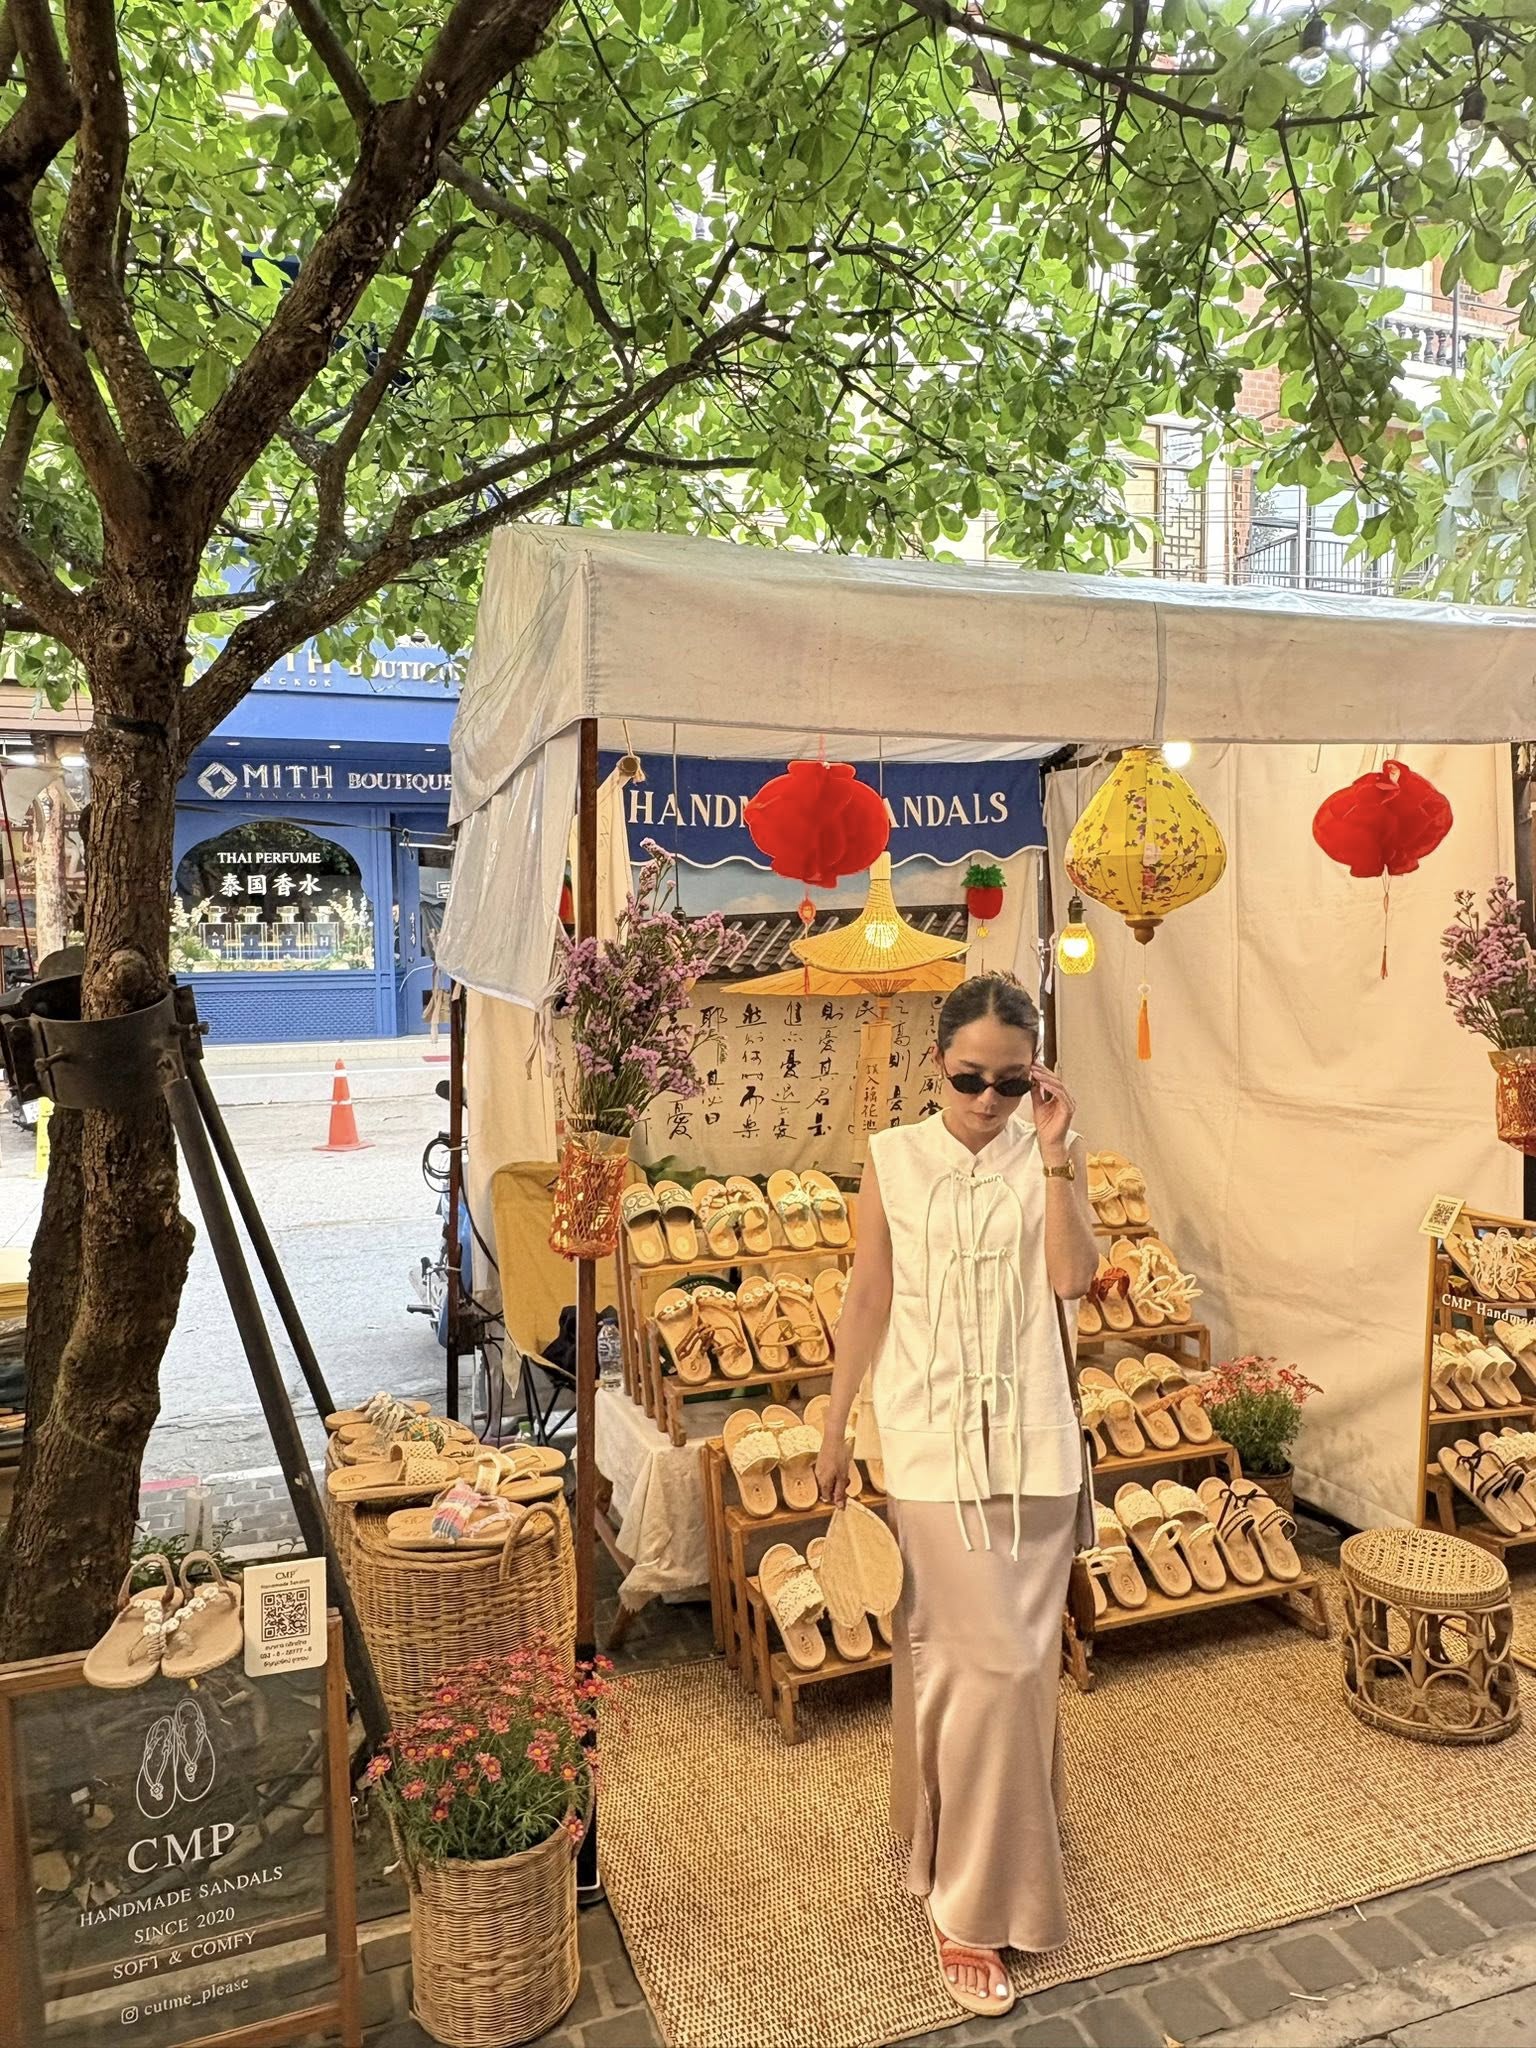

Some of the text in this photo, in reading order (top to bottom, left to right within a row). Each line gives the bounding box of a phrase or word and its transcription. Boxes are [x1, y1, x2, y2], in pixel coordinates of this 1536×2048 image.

[242, 763, 453, 794] MITH BOUTIQUE
[628, 790, 1008, 829] HAND ANDALS
[217, 852, 322, 864] THAI PERFUME
[219, 872, 323, 898] 泰国香水
[1442, 1293, 1472, 1311] CMP
[127, 1822, 235, 1874] CMP
[79, 1866, 283, 1928] HANDMADE SANDALS
[134, 1906, 236, 1944] SINCE 2020
[113, 1930, 257, 1980] SOFT & COMFY
[144, 1978, 249, 2016] cutme_please
